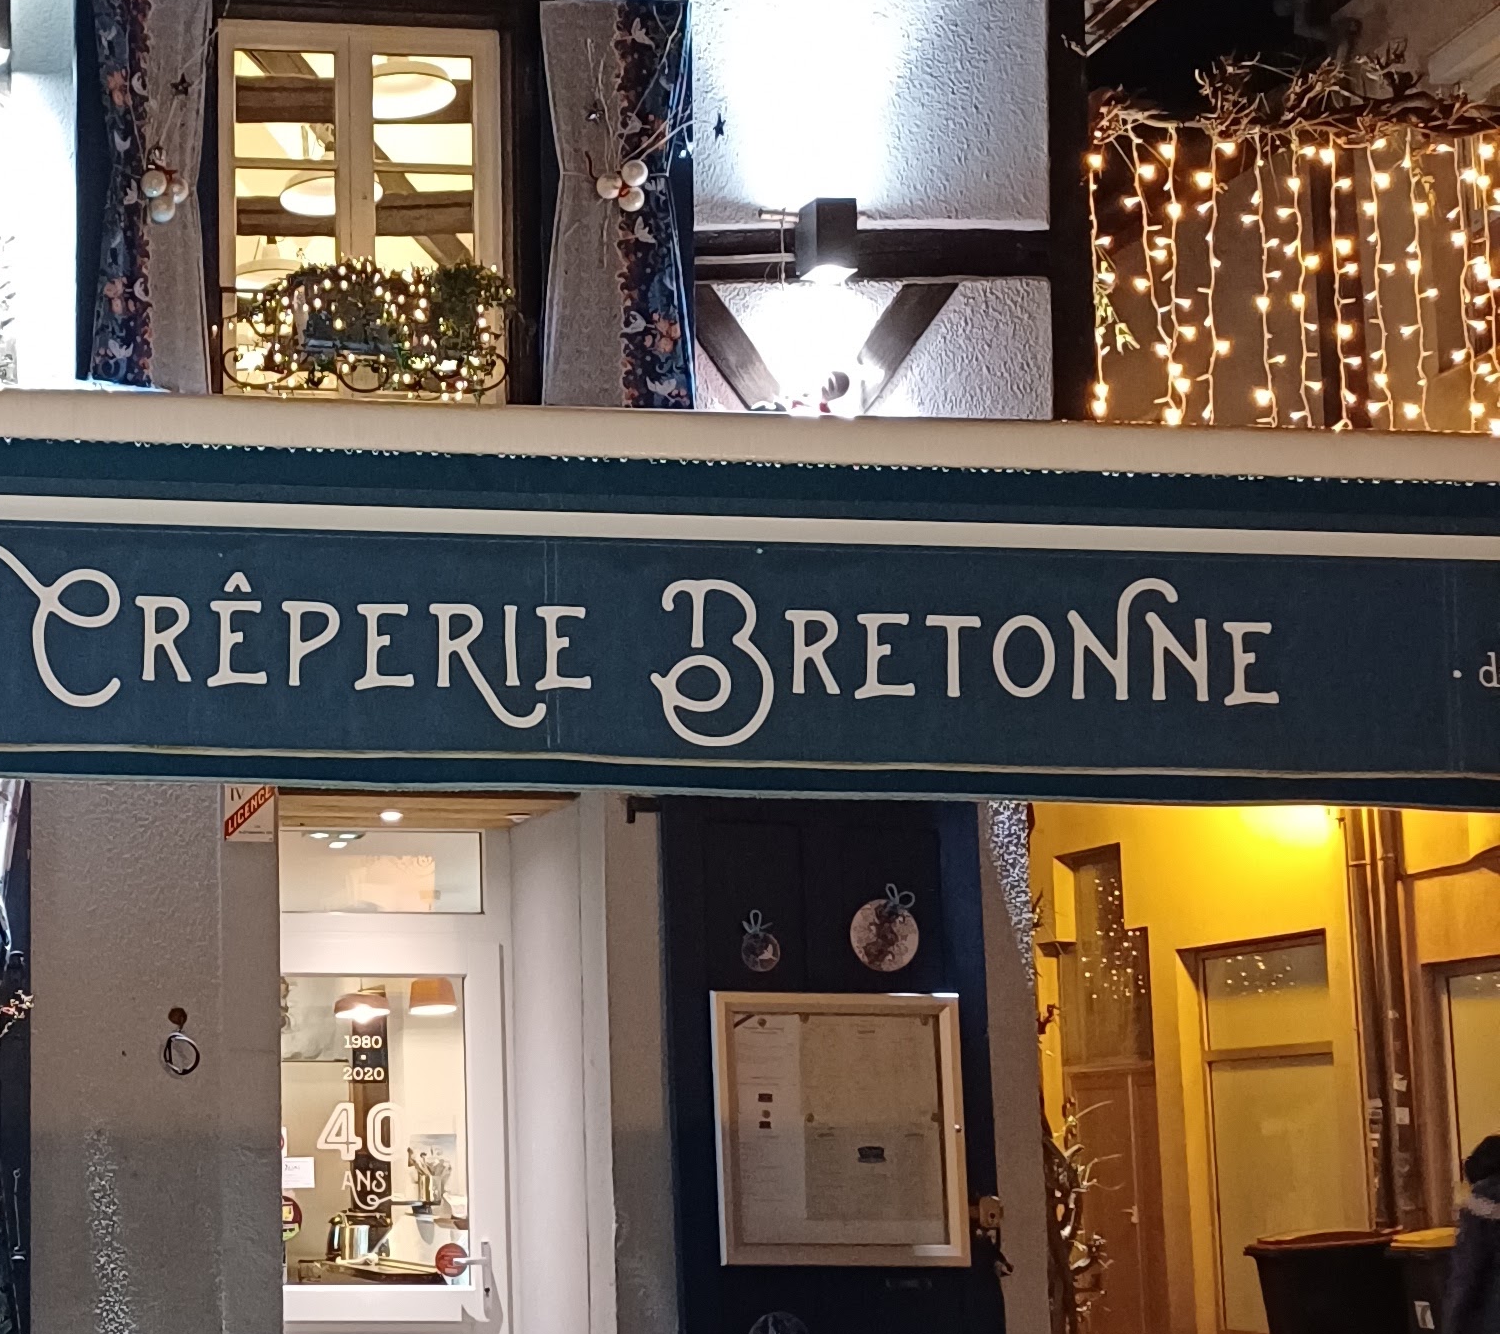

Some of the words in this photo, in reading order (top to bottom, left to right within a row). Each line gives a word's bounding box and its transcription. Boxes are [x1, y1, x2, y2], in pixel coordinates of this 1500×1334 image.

[651, 578, 1280, 746] BRETONNE
[344, 1035, 382, 1049] 1980
[342, 1067, 385, 1081] 2020
[316, 1102, 405, 1162] 40
